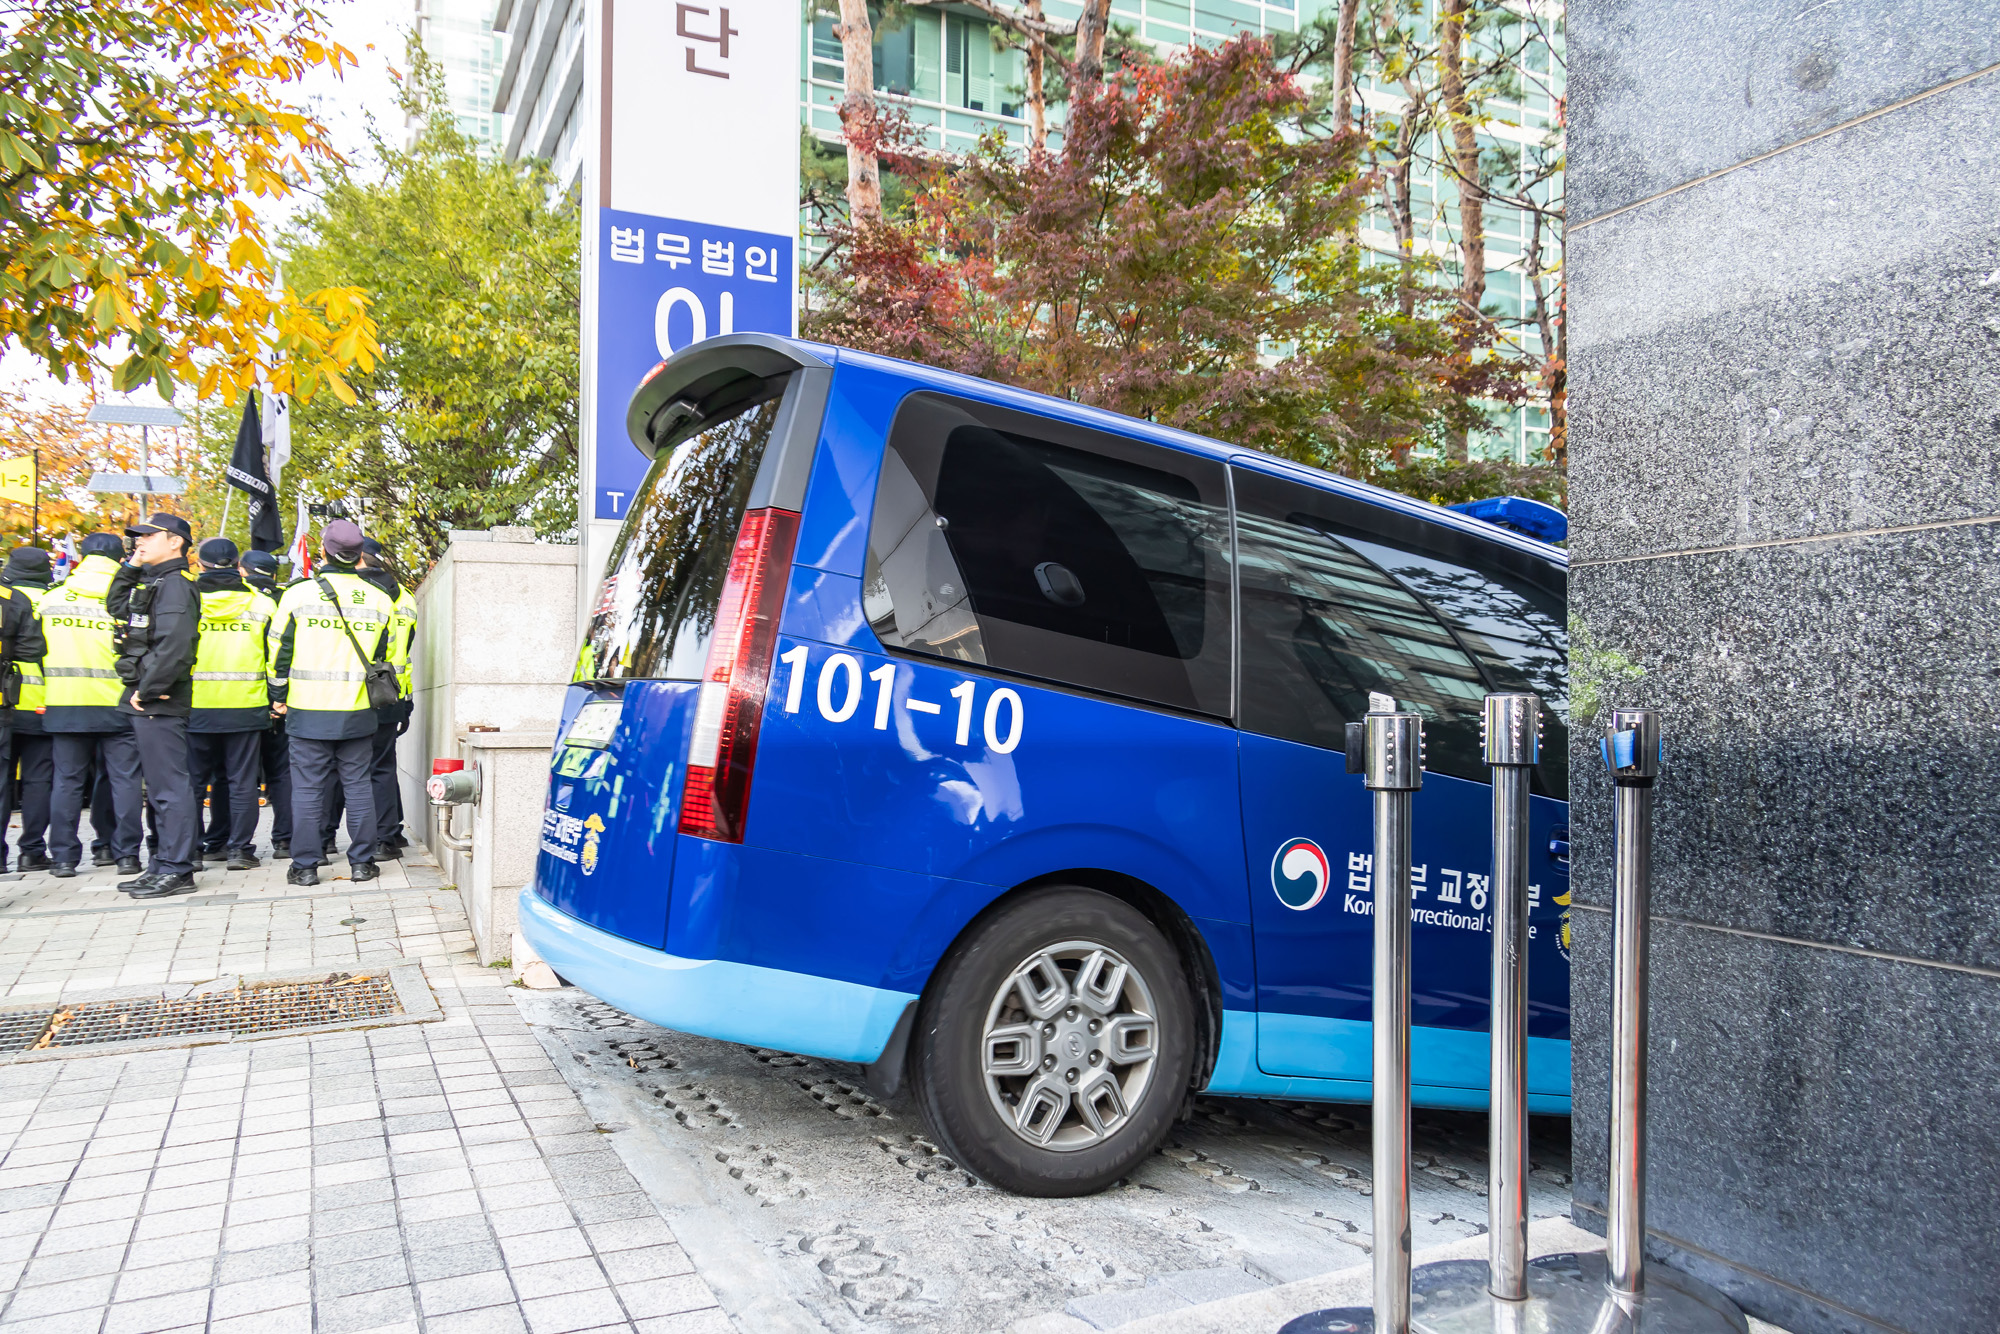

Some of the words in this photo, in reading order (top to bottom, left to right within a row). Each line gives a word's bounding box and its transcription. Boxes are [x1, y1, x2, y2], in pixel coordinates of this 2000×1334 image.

[676, 2, 738, 79] 단
[610, 225, 778, 283] 법무법인
[226, 465, 269, 494] REEDOM
[200, 622, 251, 632] OLICE
[307, 617, 376, 632] POLCE
[780, 645, 1024, 754] 101-10
[1348, 851, 1427, 900] 법부
[1343, 893, 1374, 916] Kor
[1410, 907, 1485, 931] rrectional
